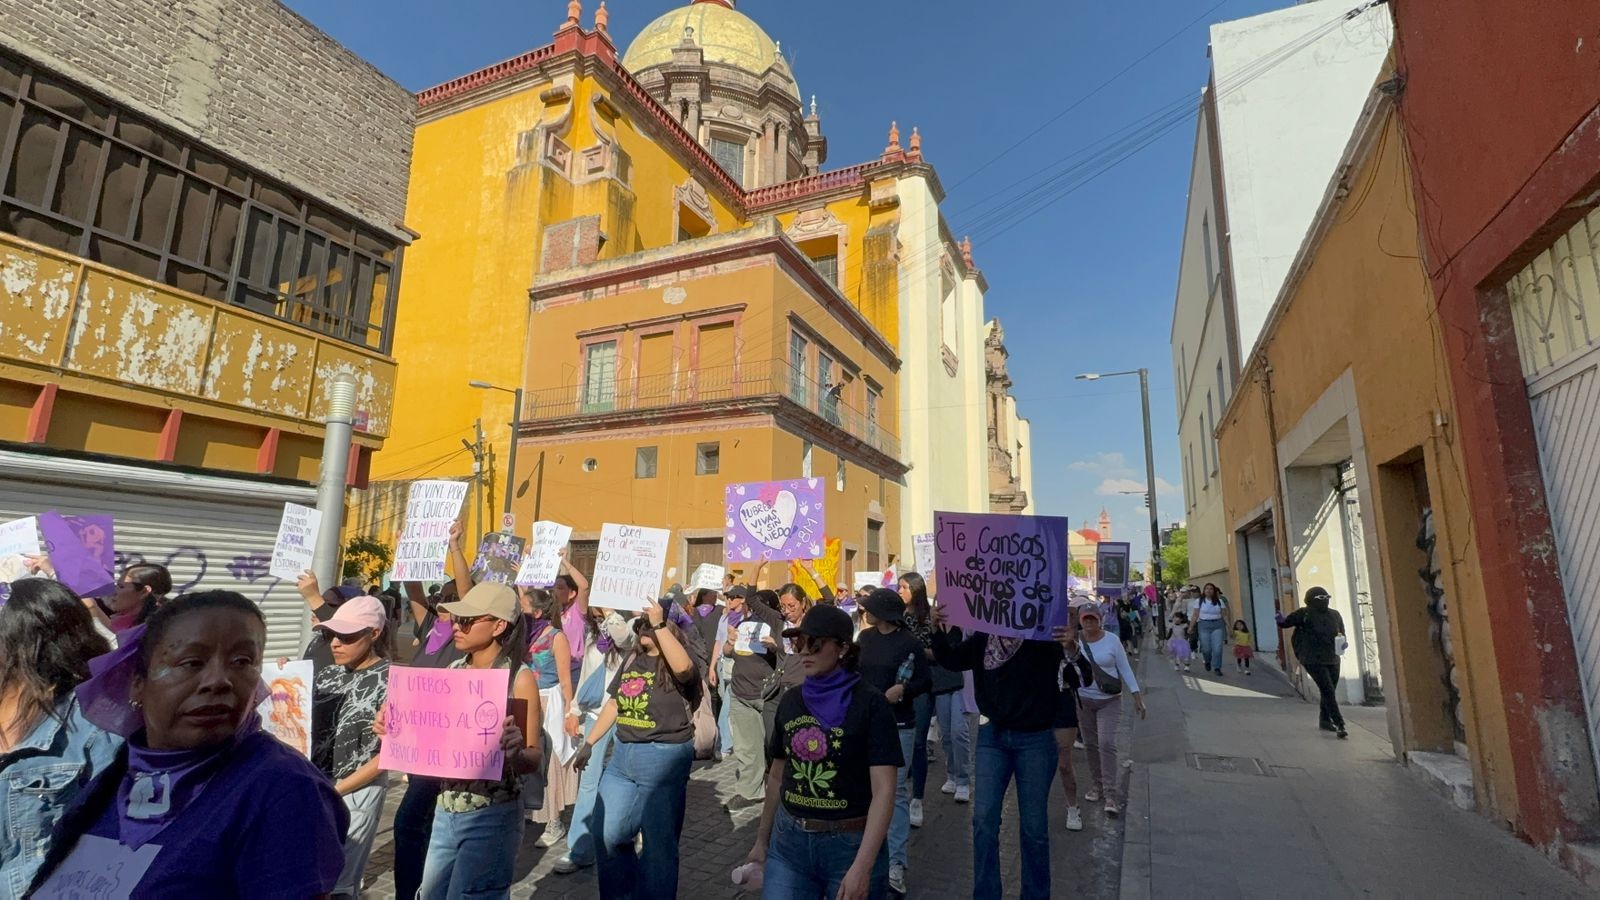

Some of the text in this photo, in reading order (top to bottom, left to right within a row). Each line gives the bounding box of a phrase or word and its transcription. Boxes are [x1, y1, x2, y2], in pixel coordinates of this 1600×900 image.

[446, 484, 466, 500] POR
[423, 500, 456, 518] QUIERO
[751, 509, 777, 528] VIVAS
[756, 517, 781, 537] Y SIN
[936, 516, 966, 553] ¿Te
[597, 551, 610, 562] no
[965, 549, 985, 571] de
[1022, 581, 1054, 604] de
[964, 592, 1046, 632] VIVIRLO!
[469, 679, 484, 699] NI
[457, 712, 473, 729] AL
[428, 749, 442, 767] DEL
[452, 750, 501, 769] SISTEMA
